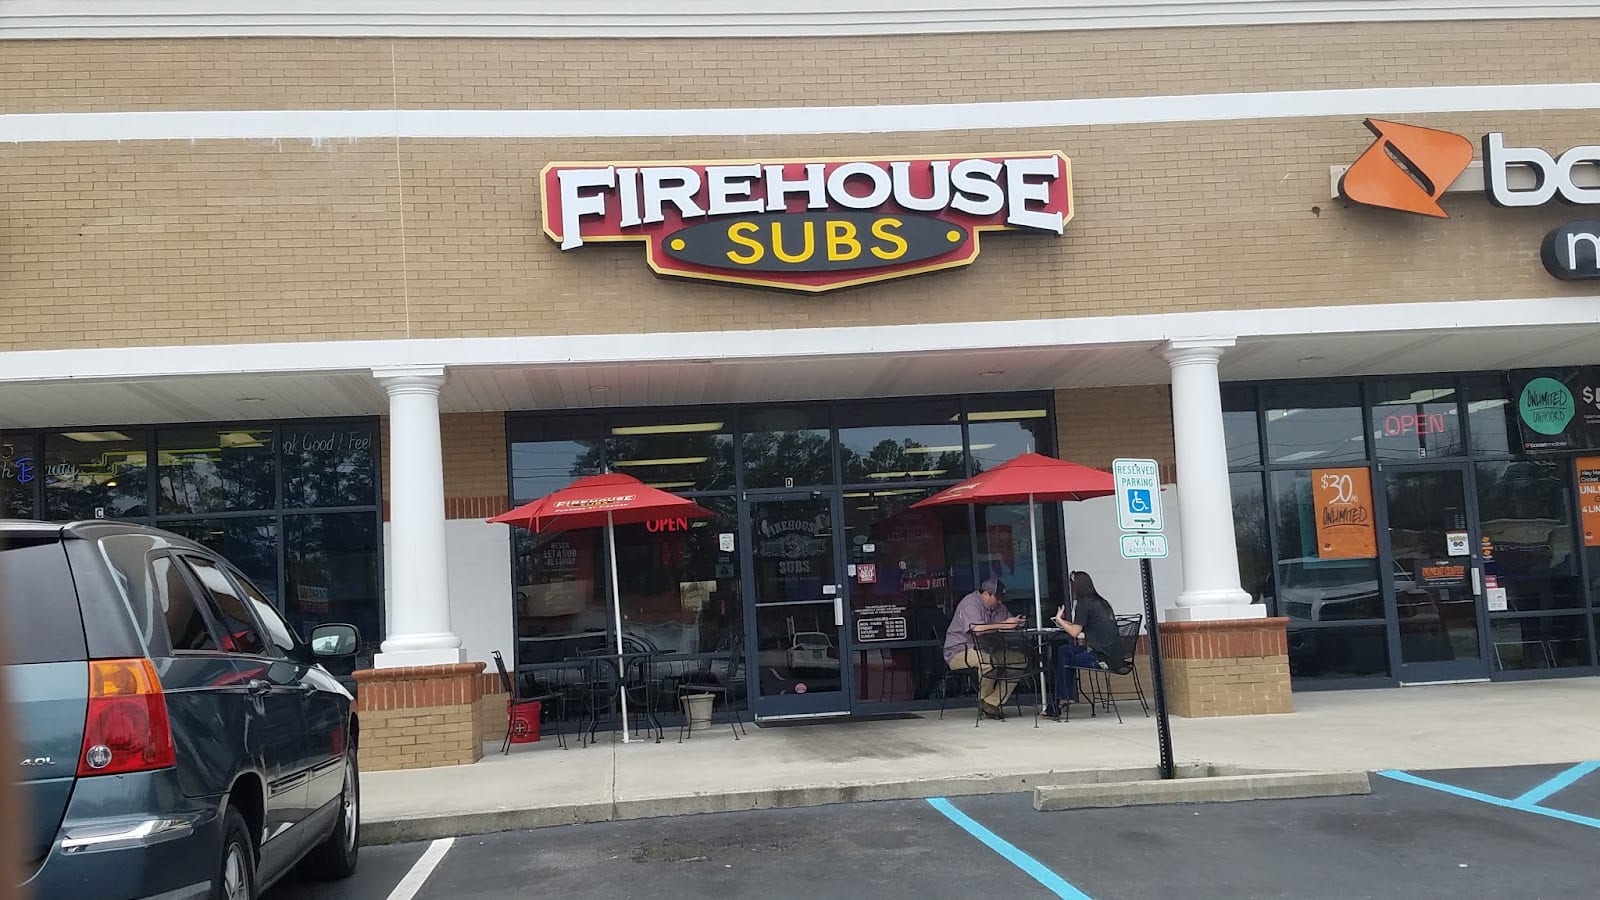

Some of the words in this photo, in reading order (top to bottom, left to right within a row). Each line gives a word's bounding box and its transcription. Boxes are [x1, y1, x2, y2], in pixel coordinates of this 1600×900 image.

[557, 155, 1065, 250] FIREHOUSE
[726, 218, 908, 266] SUBS
[1385, 413, 1444, 436] OPEN
[348, 432, 372, 450] Feel
[1117, 465, 1155, 475] RESERVED
[785, 477, 794, 489] D
[1121, 477, 1153, 487] PARKING
[554, 495, 637, 508] FIREHOUSE
[1323, 507, 1367, 526] UNLIMITED
[646, 517, 688, 532] OPEN
[20, 757, 56, 766] 4.0L
